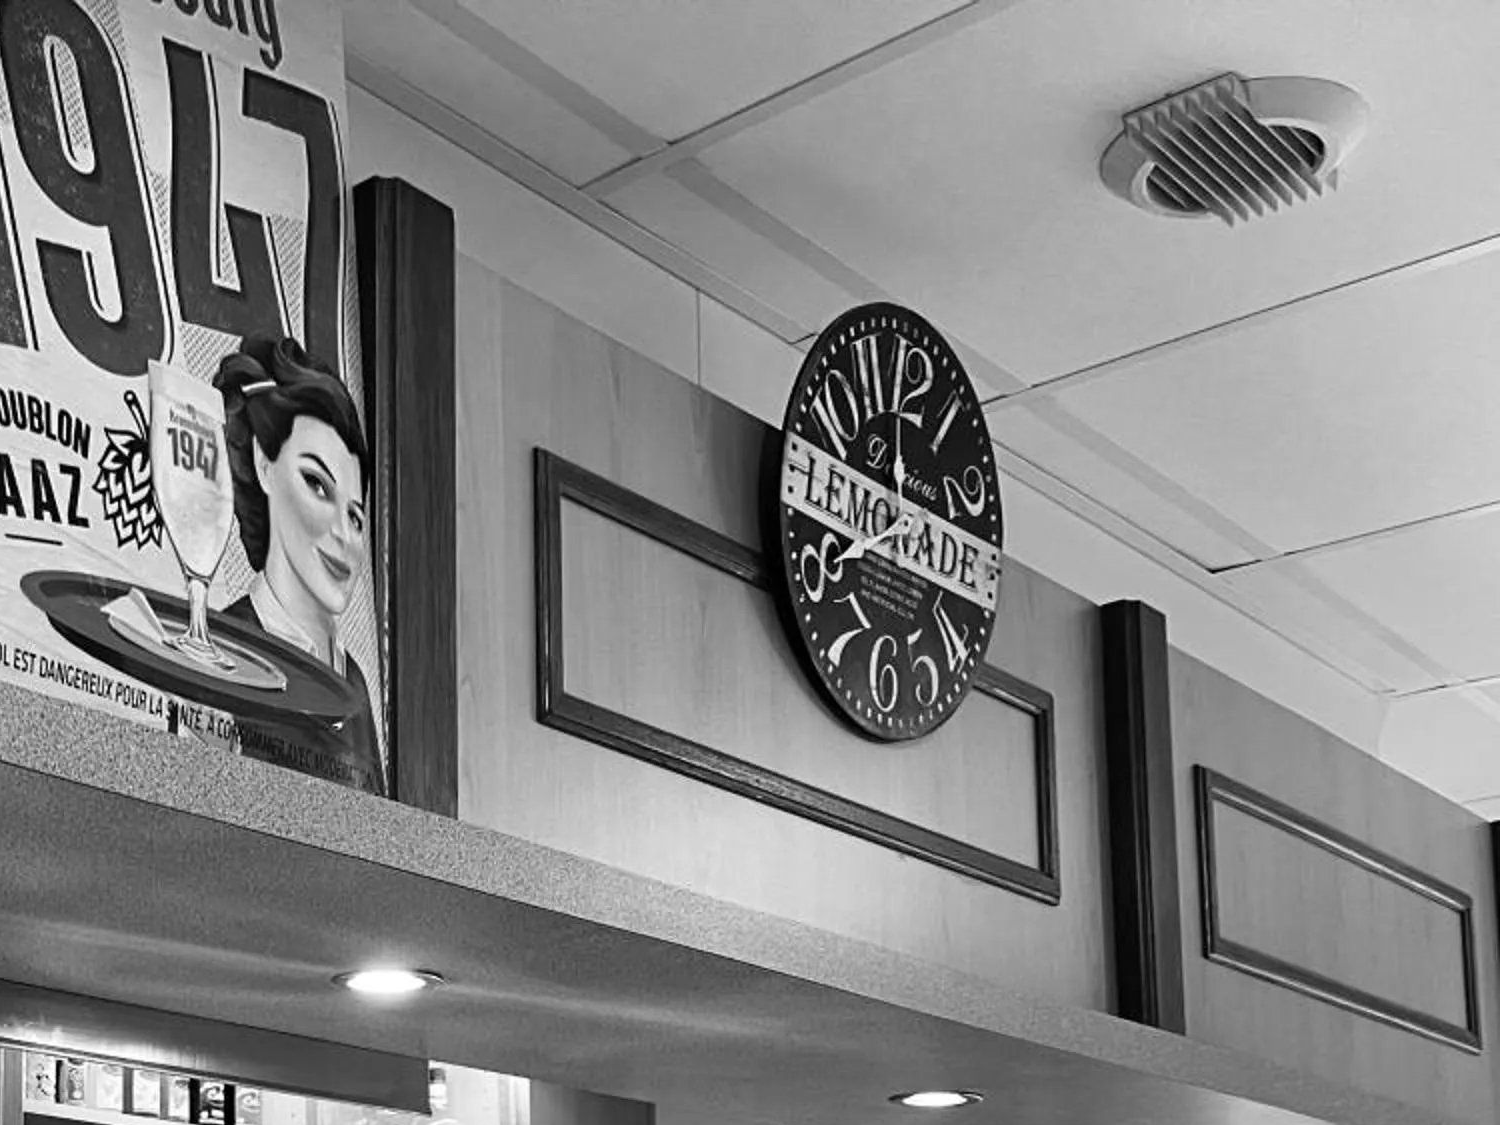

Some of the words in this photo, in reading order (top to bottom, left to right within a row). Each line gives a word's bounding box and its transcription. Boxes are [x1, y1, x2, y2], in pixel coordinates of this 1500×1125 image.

[810, 369, 859, 461] 10
[167, 427, 218, 481] 1947
[945, 465, 985, 519] 2
[801, 532, 843, 603] 8
[828, 592, 871, 666] 7
[932, 591, 971, 673] 4
[14, 648, 36, 675] EST
[39, 656, 113, 700] DANGEREUX
[116, 677, 146, 708] POUR
[149, 691, 162, 718] LA
[869, 635, 899, 713] 6
[908, 629, 939, 706] 5
